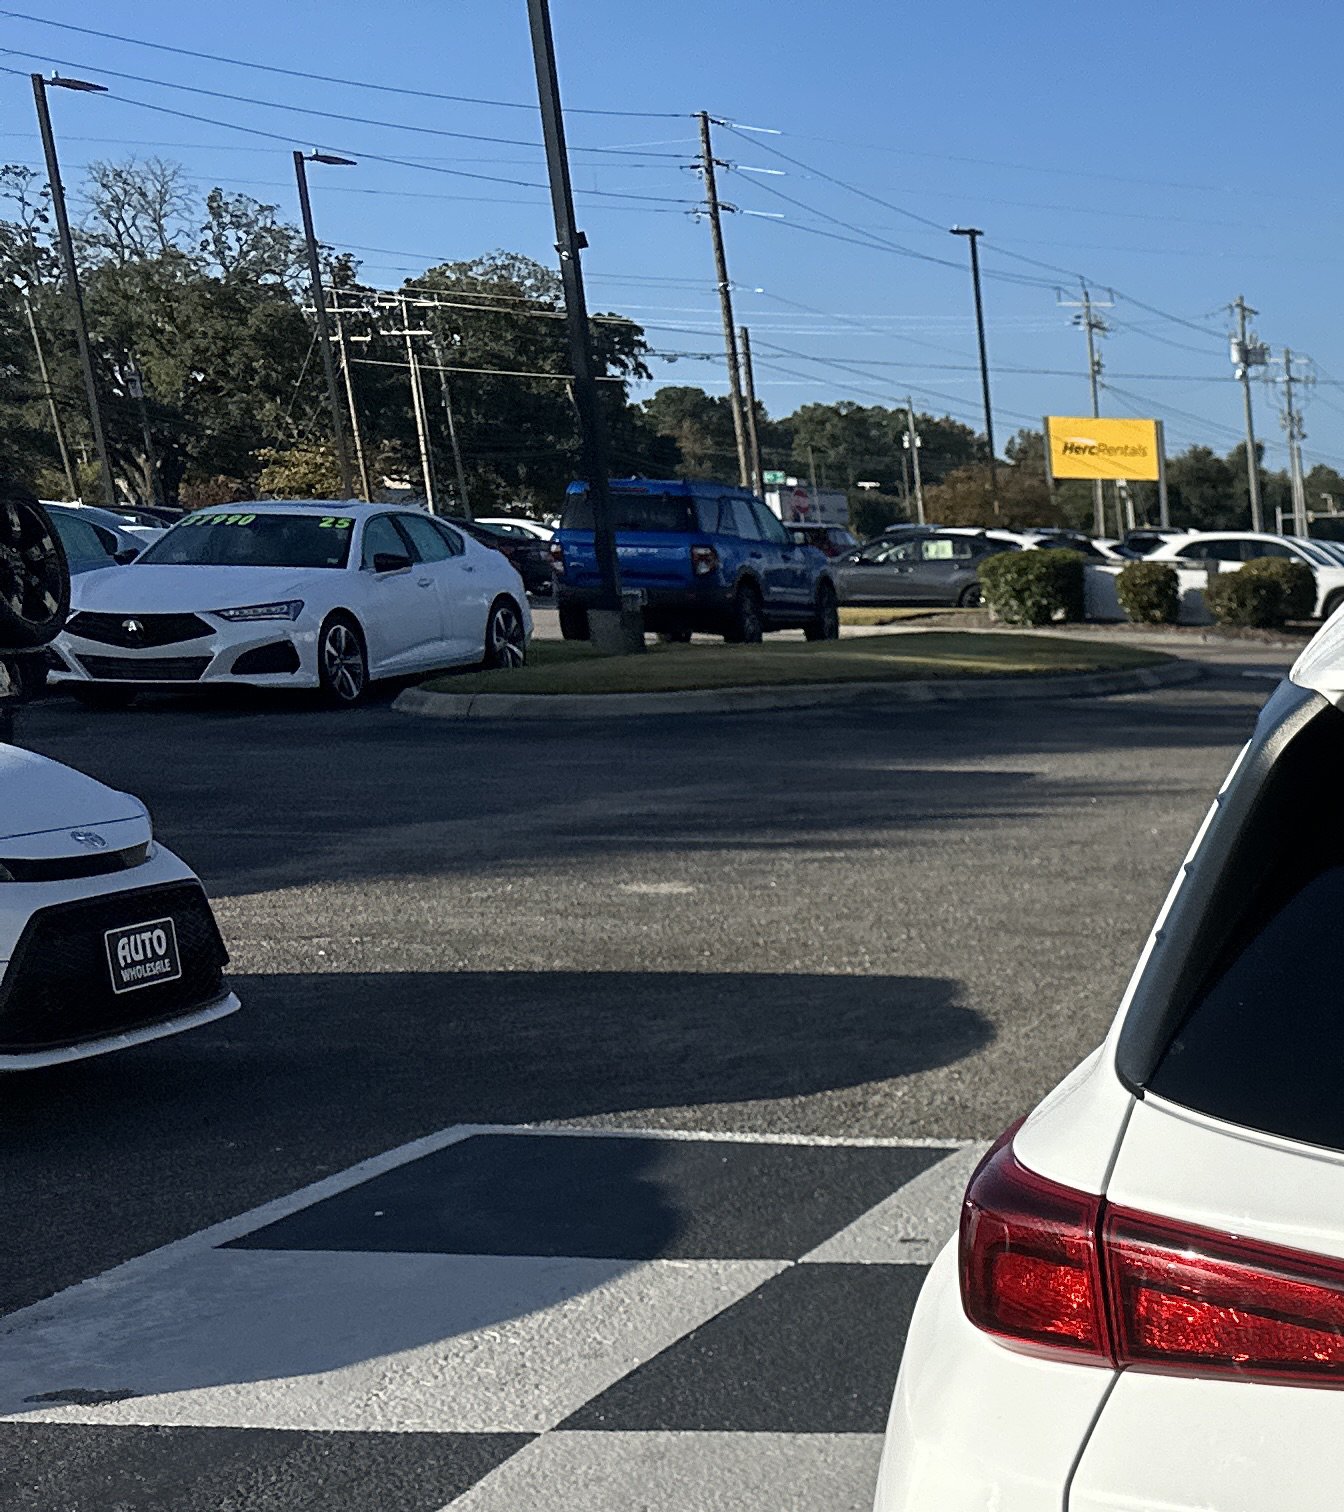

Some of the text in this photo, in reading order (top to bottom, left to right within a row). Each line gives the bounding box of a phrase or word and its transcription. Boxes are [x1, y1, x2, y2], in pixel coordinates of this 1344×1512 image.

[1062, 441, 1148, 458] HercRentals
[318, 516, 352, 529] 25
[117, 928, 167, 968] AUTO
[121, 958, 172, 982] WHOLESALE
